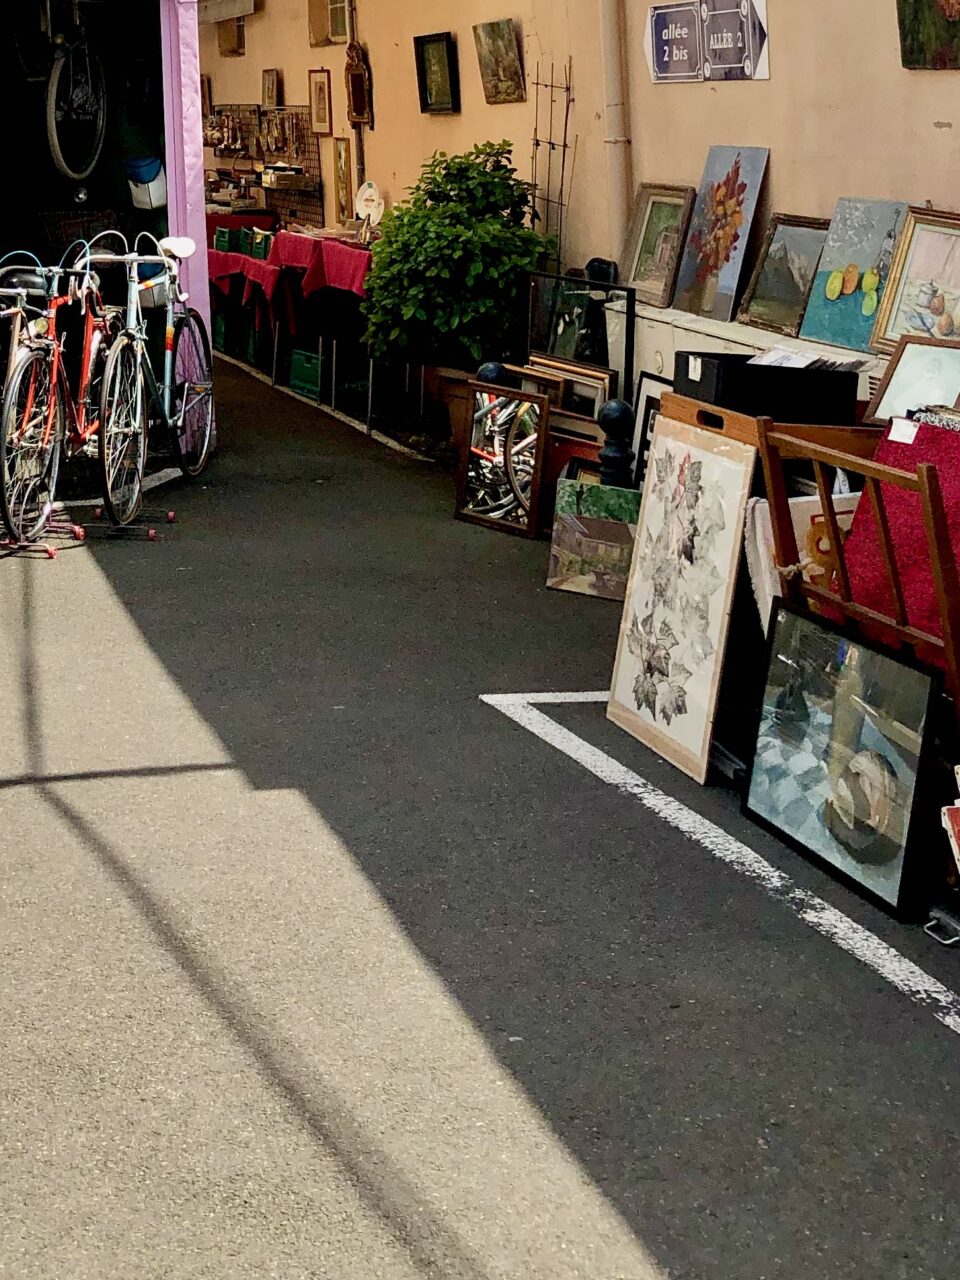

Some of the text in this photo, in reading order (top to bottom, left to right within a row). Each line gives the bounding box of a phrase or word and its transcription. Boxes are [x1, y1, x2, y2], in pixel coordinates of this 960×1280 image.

[662, 23, 689, 40] allée
[709, 28, 742, 49] ALLÉE 2
[663, 45, 688, 62] 2 bis
